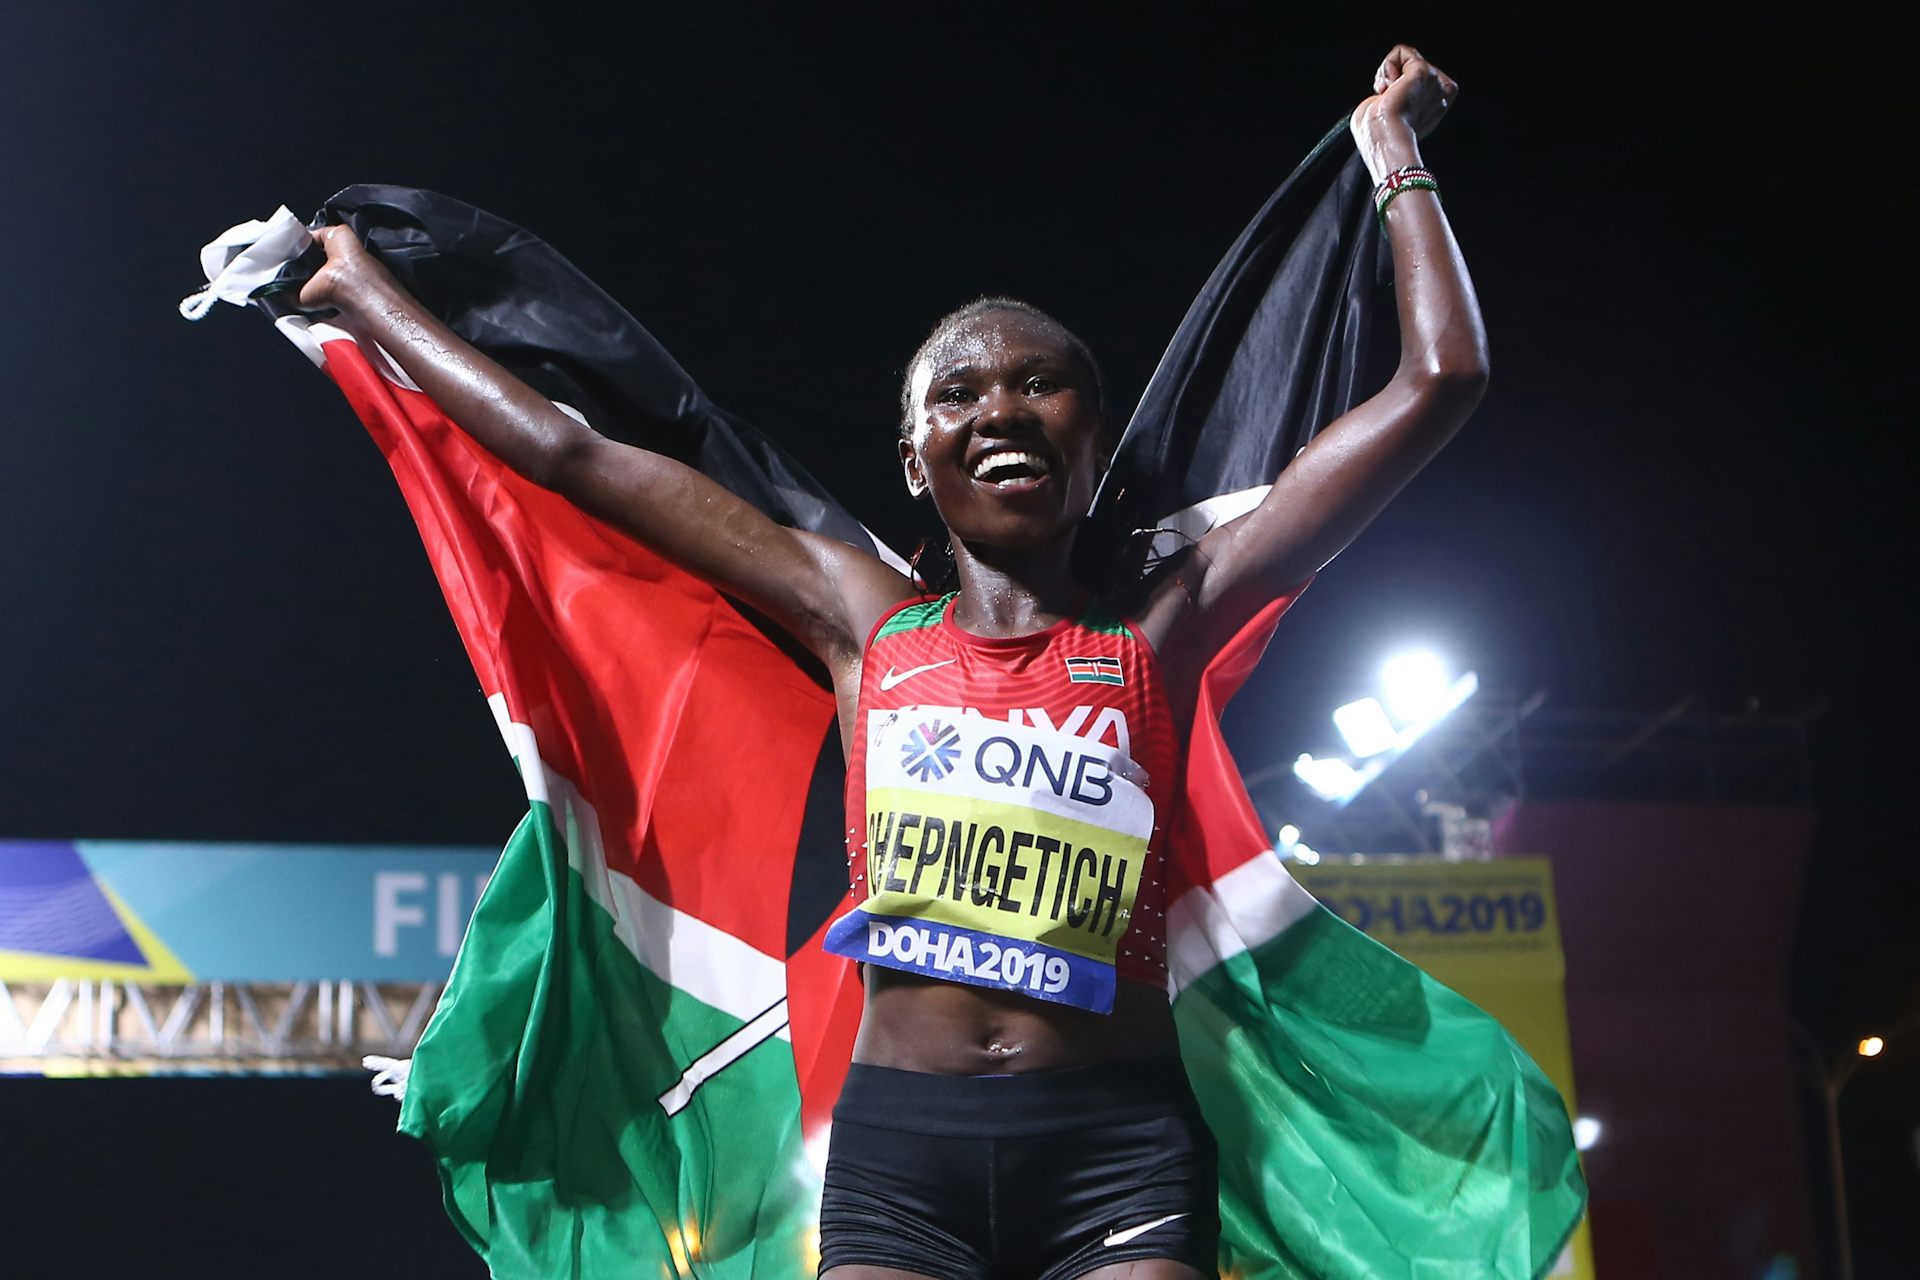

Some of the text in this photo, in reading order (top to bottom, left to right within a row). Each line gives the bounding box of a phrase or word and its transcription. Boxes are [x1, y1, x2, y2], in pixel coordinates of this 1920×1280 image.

[974, 736, 1114, 806] QNB
[868, 811, 1128, 937] CHEPNGETICH
[375, 872, 492, 956] FI
[867, 921, 1071, 994] DOHA2019
